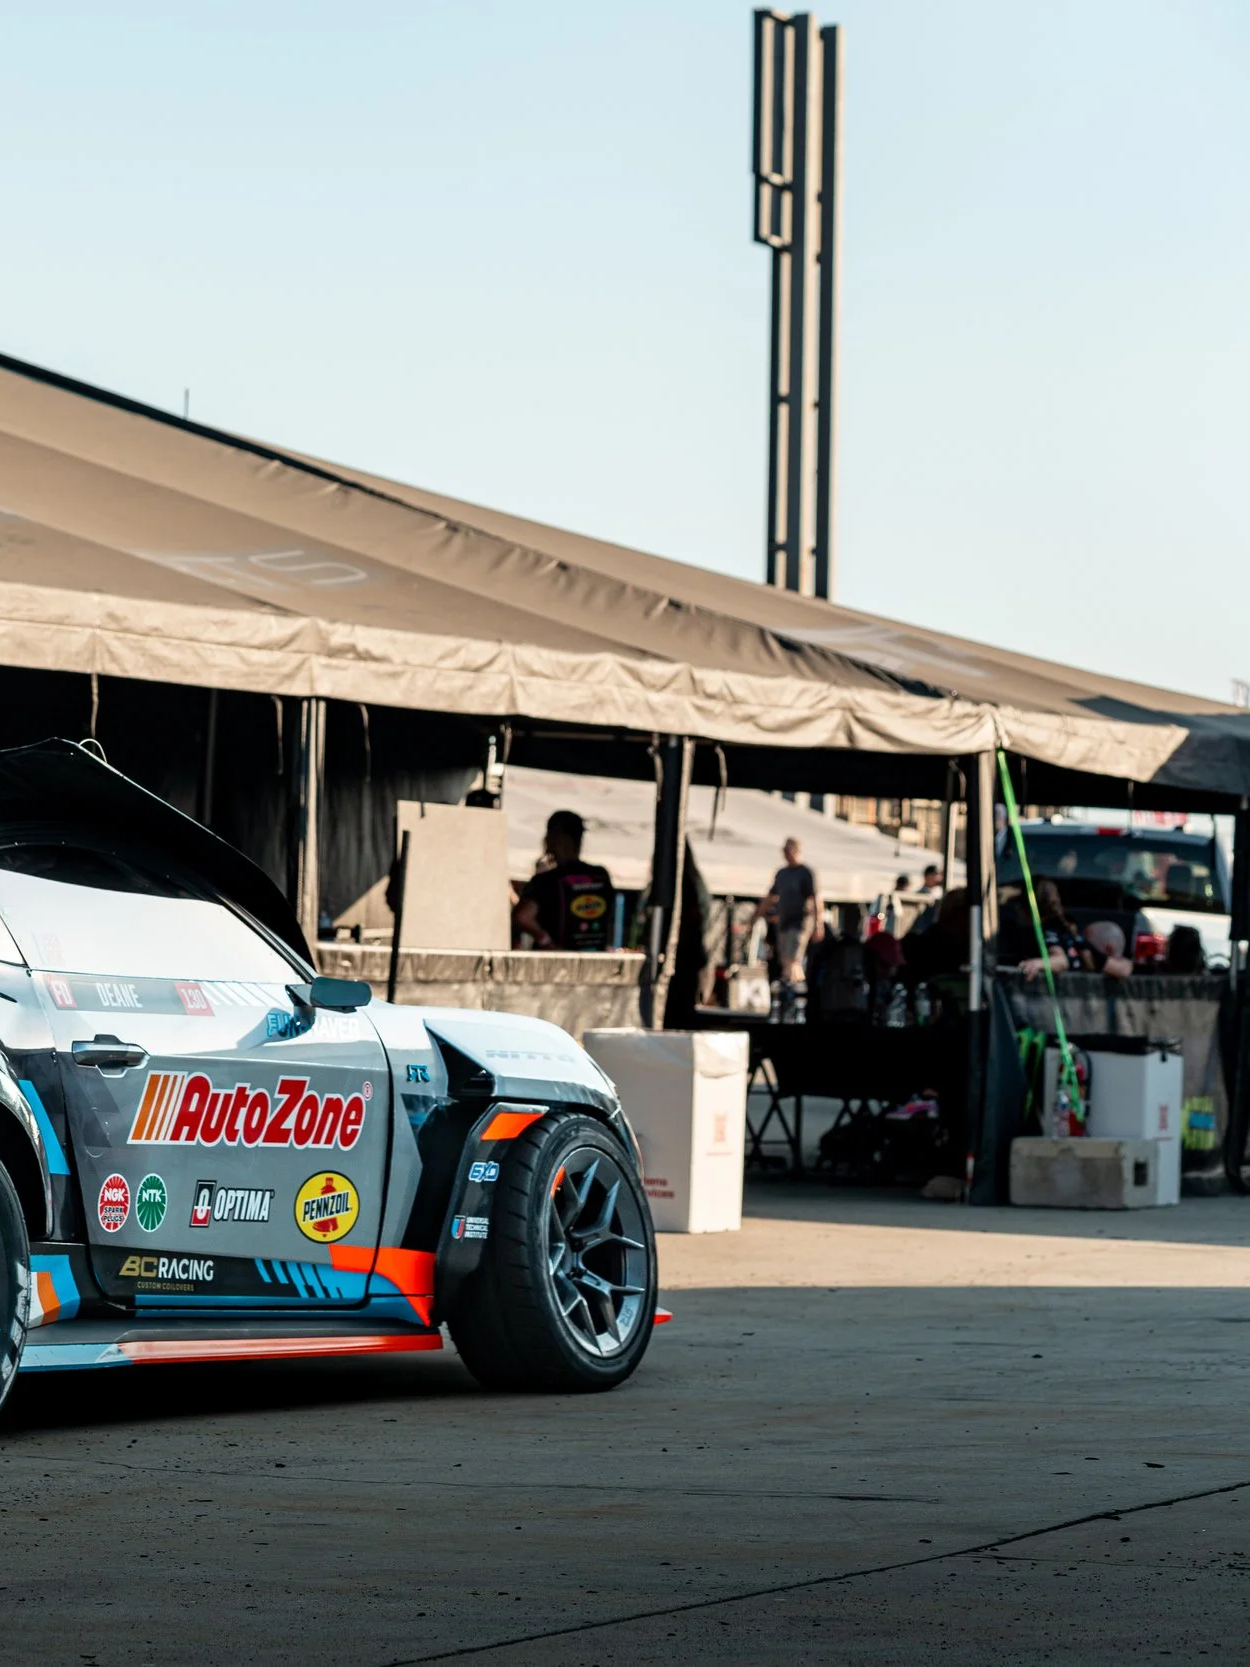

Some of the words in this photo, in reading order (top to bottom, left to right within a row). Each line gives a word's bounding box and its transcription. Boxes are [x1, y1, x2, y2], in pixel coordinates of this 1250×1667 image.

[96, 983, 143, 1008] DEANE
[179, 988, 208, 1010] 130
[169, 1074, 365, 1149] AutoZone
[103, 1188, 126, 1202] NGK
[141, 1189, 162, 1203] NTK
[213, 1188, 271, 1222] OPTIMA
[103, 1206, 124, 1214] SPARK
[303, 1191, 351, 1223] PENNZOIL
[137, 1281, 161, 1289] CUSTOM
[163, 1282, 194, 1292] COILOVERS
